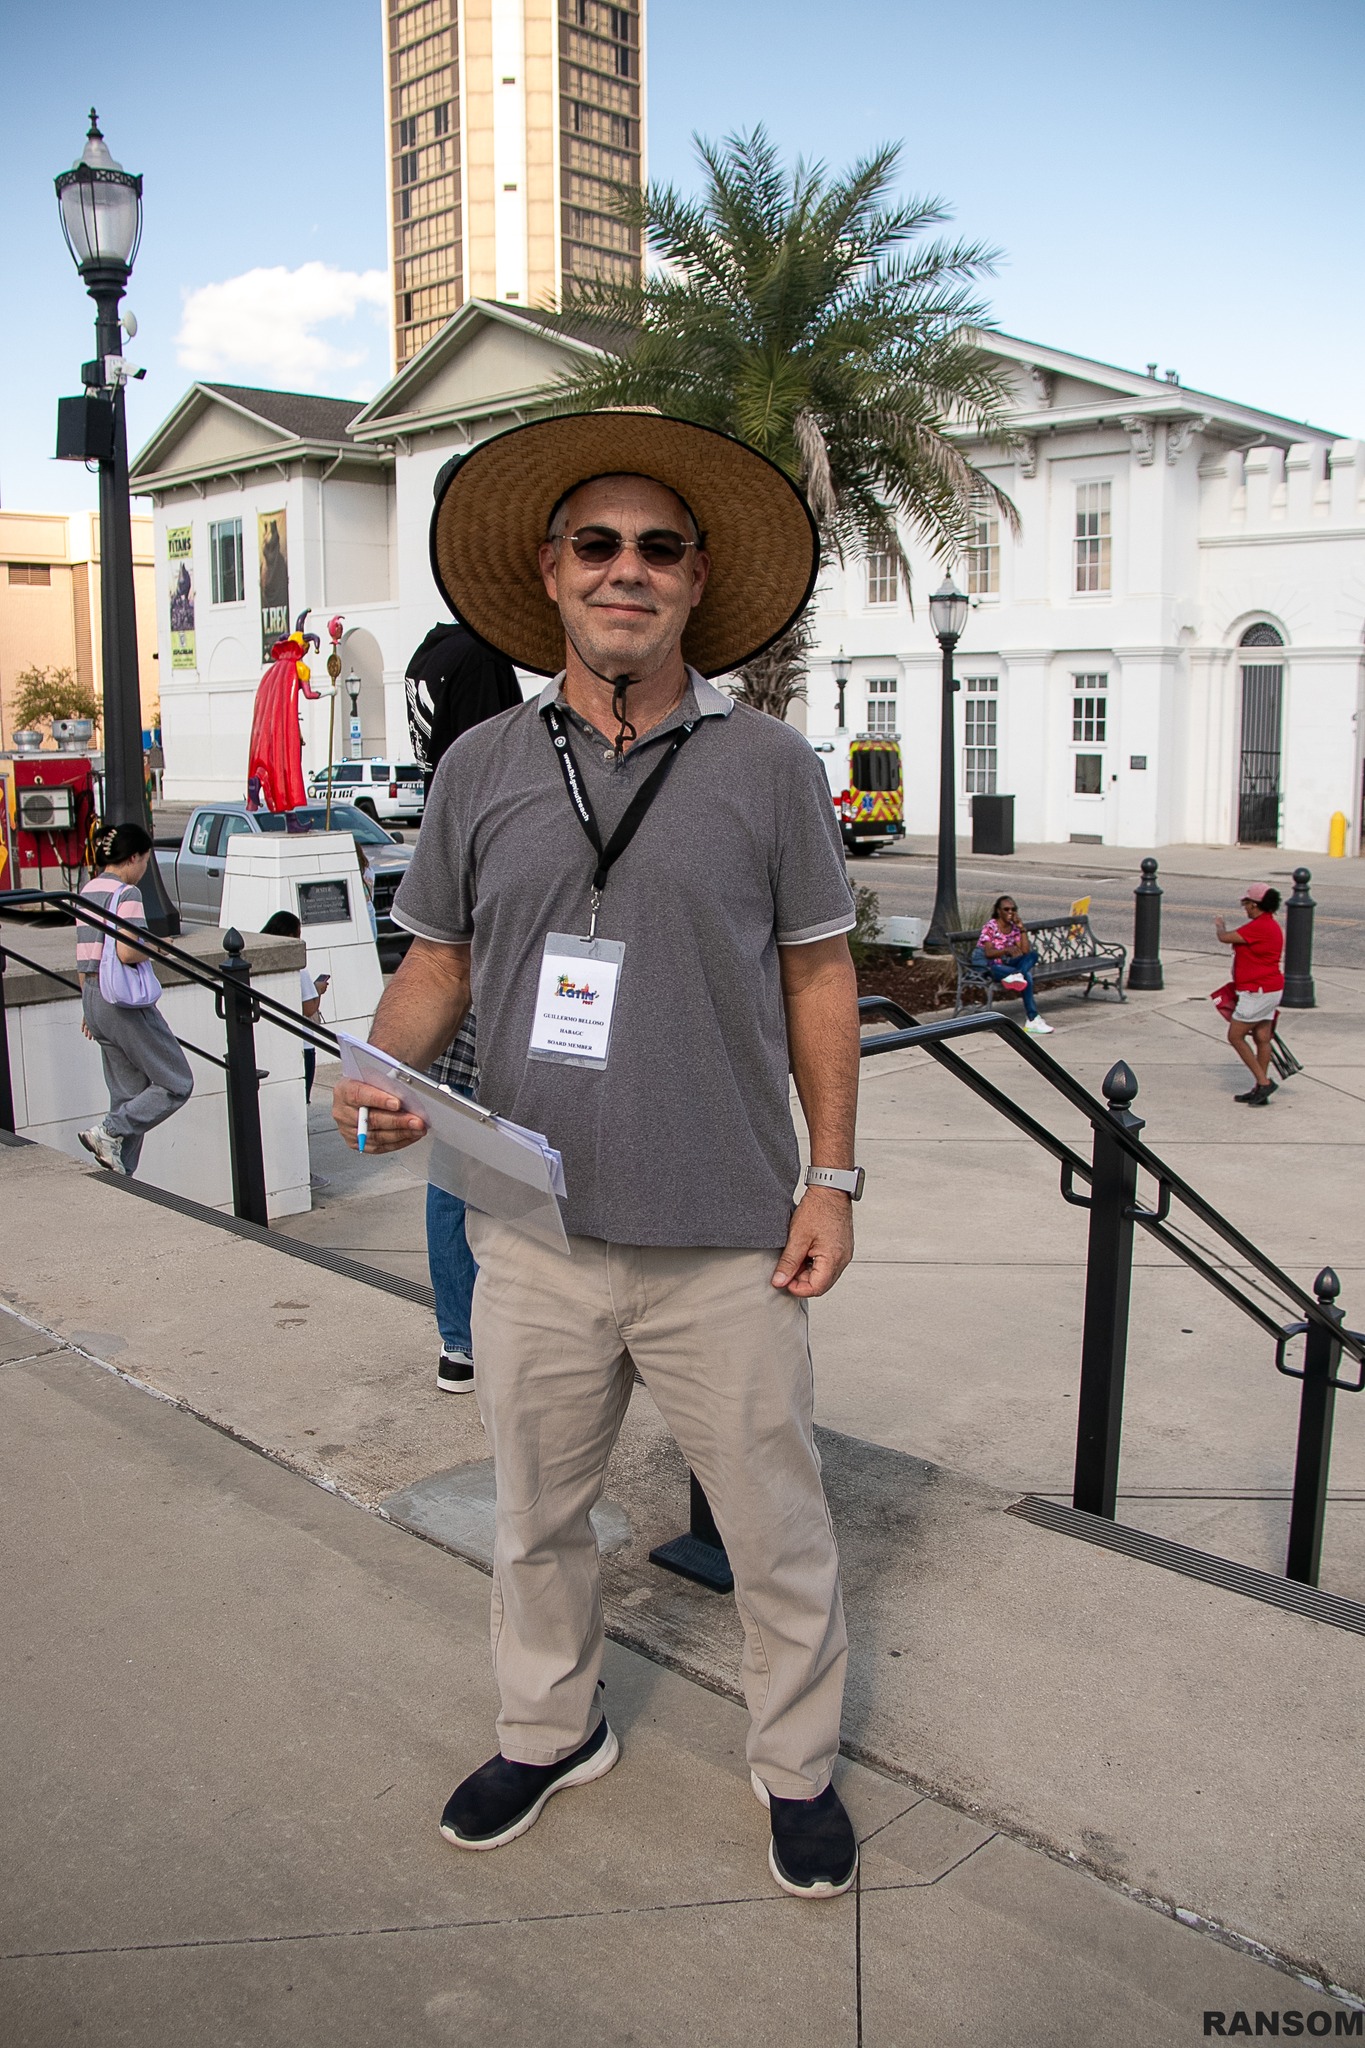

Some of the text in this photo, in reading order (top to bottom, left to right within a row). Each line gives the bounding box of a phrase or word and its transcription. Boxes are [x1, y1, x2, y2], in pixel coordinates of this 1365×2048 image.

[168, 537, 191, 553] TITANS
[262, 605, 287, 634] T.REX
[563, 752, 590, 822] www.fbi.gov/outreach
[543, 1012, 605, 1026] GUILLERMO BELLOSO
[547, 1039, 593, 1051] BOARD MEMBER
